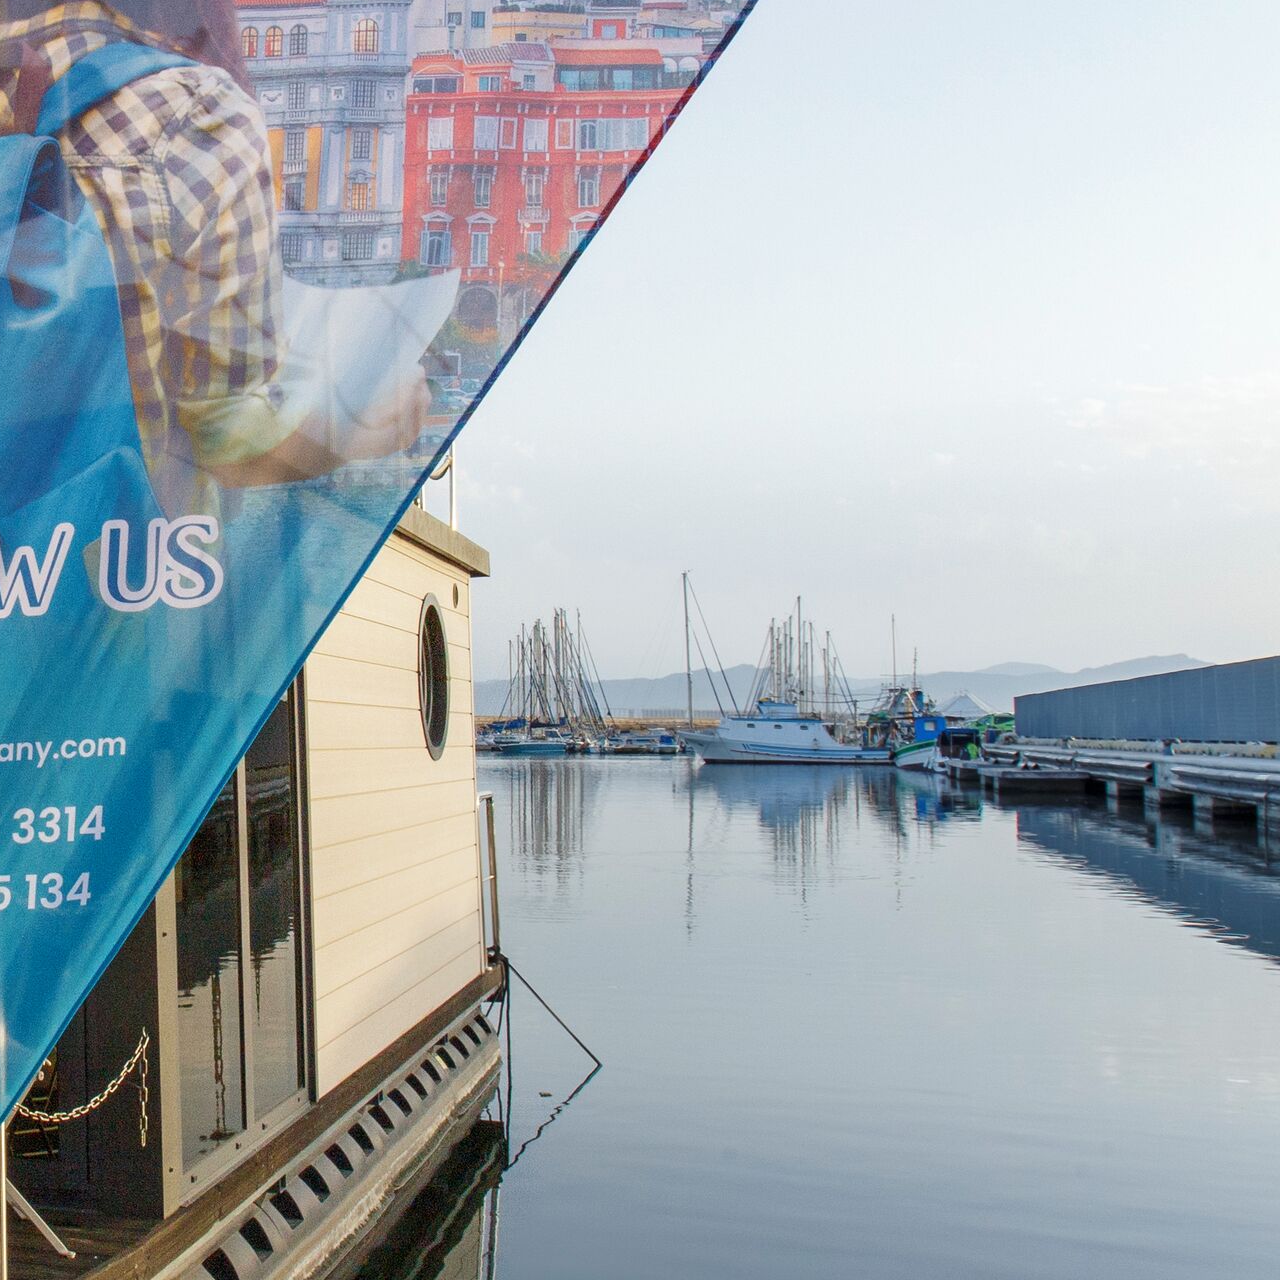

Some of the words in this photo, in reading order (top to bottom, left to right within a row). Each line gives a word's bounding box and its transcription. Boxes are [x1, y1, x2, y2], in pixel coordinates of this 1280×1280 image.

[100, 515, 224, 611] US
[12, 805, 106, 844] 3314
[25, 872, 92, 910] 134
